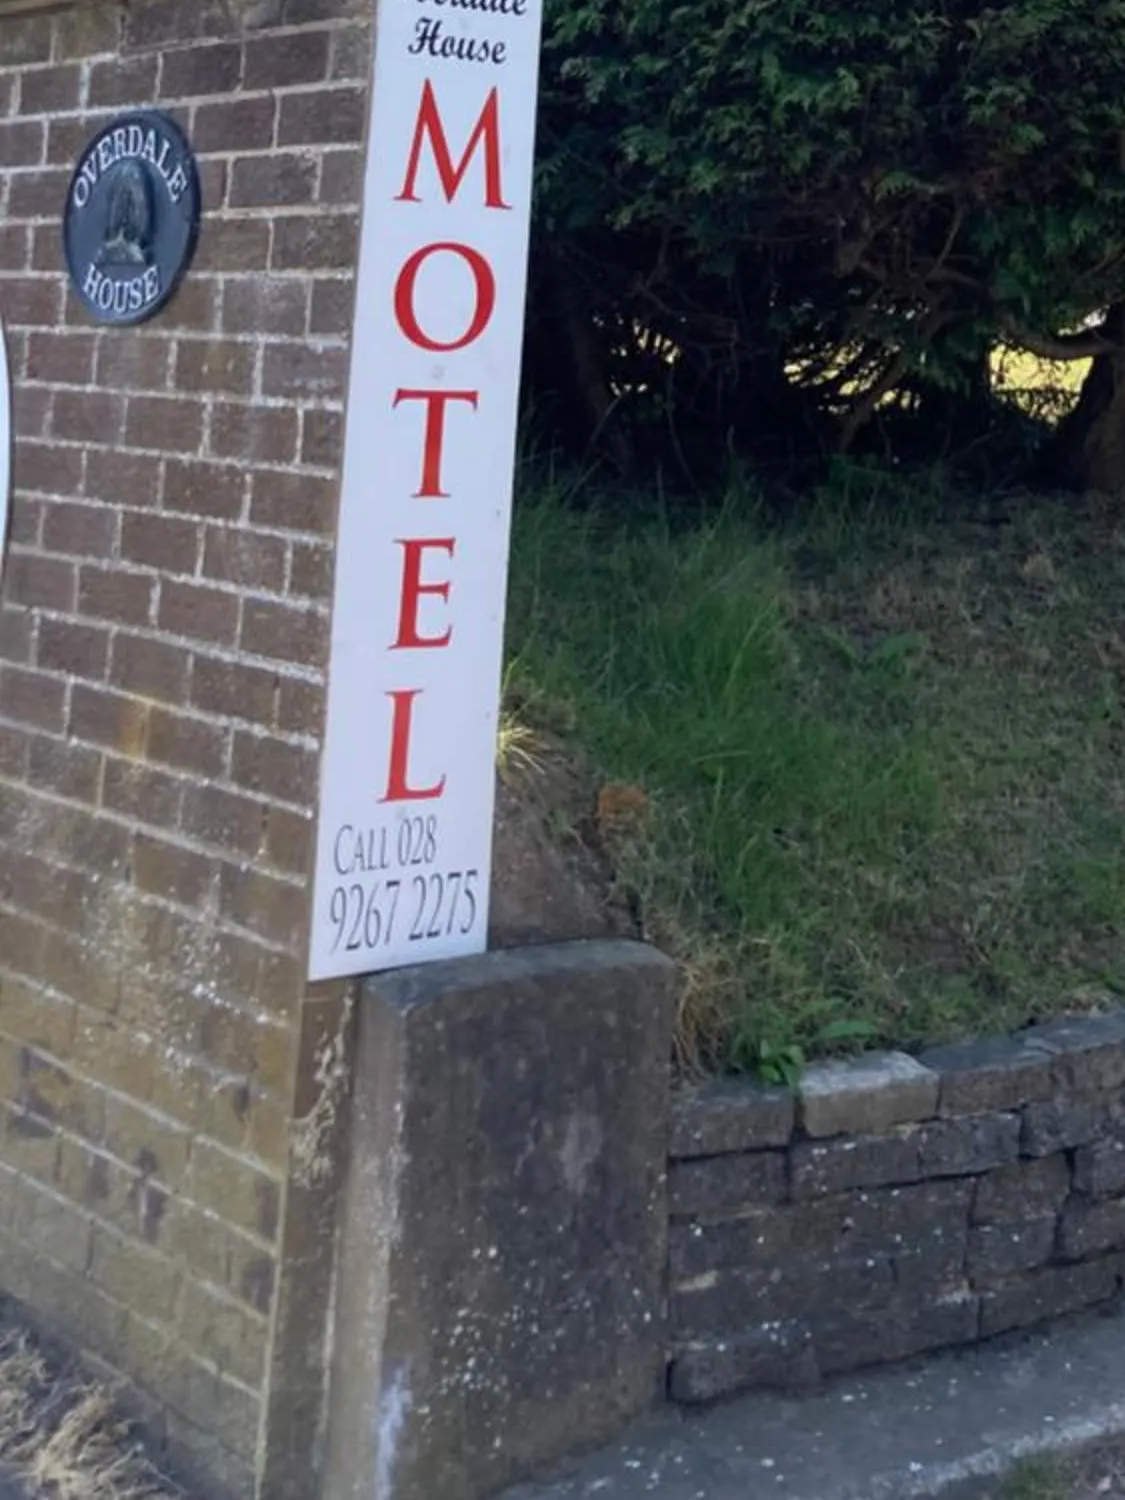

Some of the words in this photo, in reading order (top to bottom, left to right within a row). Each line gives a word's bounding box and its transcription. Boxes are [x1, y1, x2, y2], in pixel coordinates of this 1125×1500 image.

[408, 16, 507, 64] House
[73, 125, 187, 208] OVERDALE
[83, 263, 160, 313] HOUSE
[378, 77, 513, 803] MOTEL
[333, 824, 389, 875] CALL
[397, 814, 438, 866] 028
[329, 879, 401, 956] 9267
[408, 869, 479, 941] 2275
